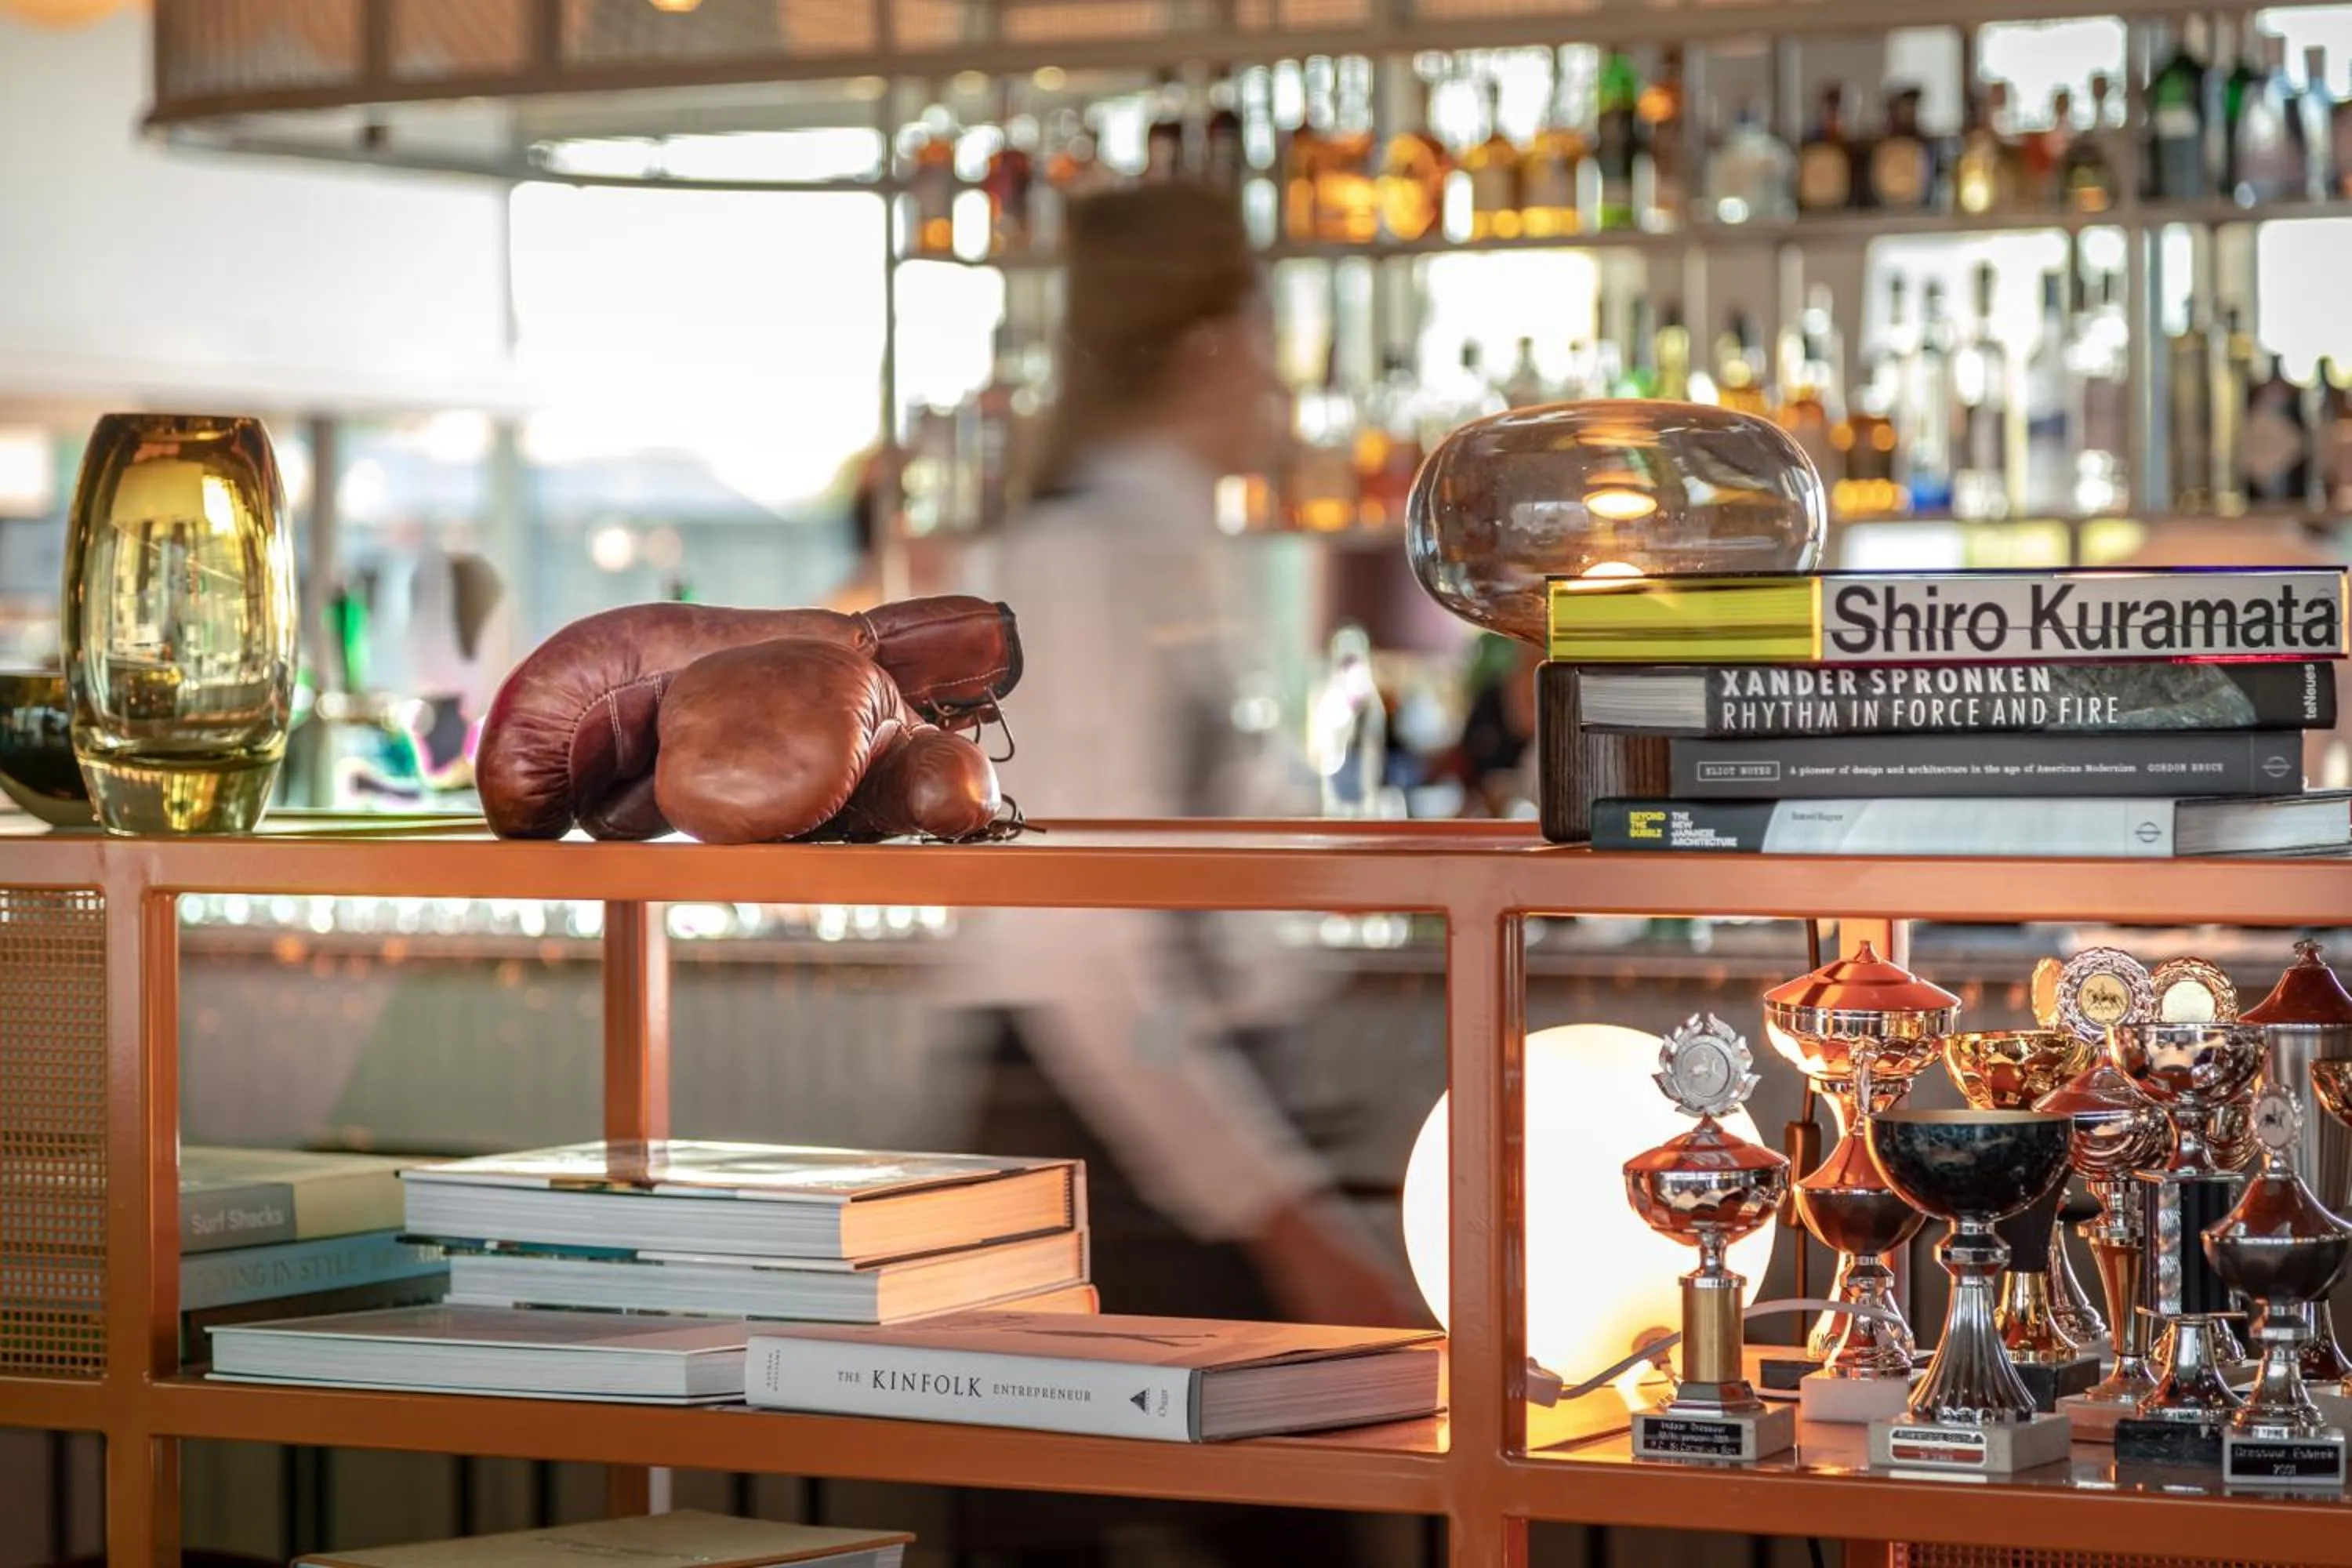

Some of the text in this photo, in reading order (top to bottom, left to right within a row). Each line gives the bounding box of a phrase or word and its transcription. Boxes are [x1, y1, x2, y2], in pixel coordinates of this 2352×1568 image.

[1830, 583, 2336, 655] Shiro Kuramata
[1722, 666, 2051, 696] XANDER SPRONKEN
[1723, 696, 2119, 729] RHYTHM IN FORCE AND FIRE
[1800, 766, 1837, 777] pioneer
[1839, 765, 1850, 775] of
[1853, 765, 1883, 777] design
[1887, 765, 1905, 775] and
[1907, 764, 1968, 775] architecture
[1971, 764, 1981, 774] in
[1984, 764, 2001, 774] the
[2004, 766, 2020, 776] age
[2024, 764, 2035, 773] of
[2038, 764, 2082, 774] American
[2147, 763, 2187, 773] GORDON
[837, 1370, 1091, 1403] THE KINFOLK ENTREPRENEUR
